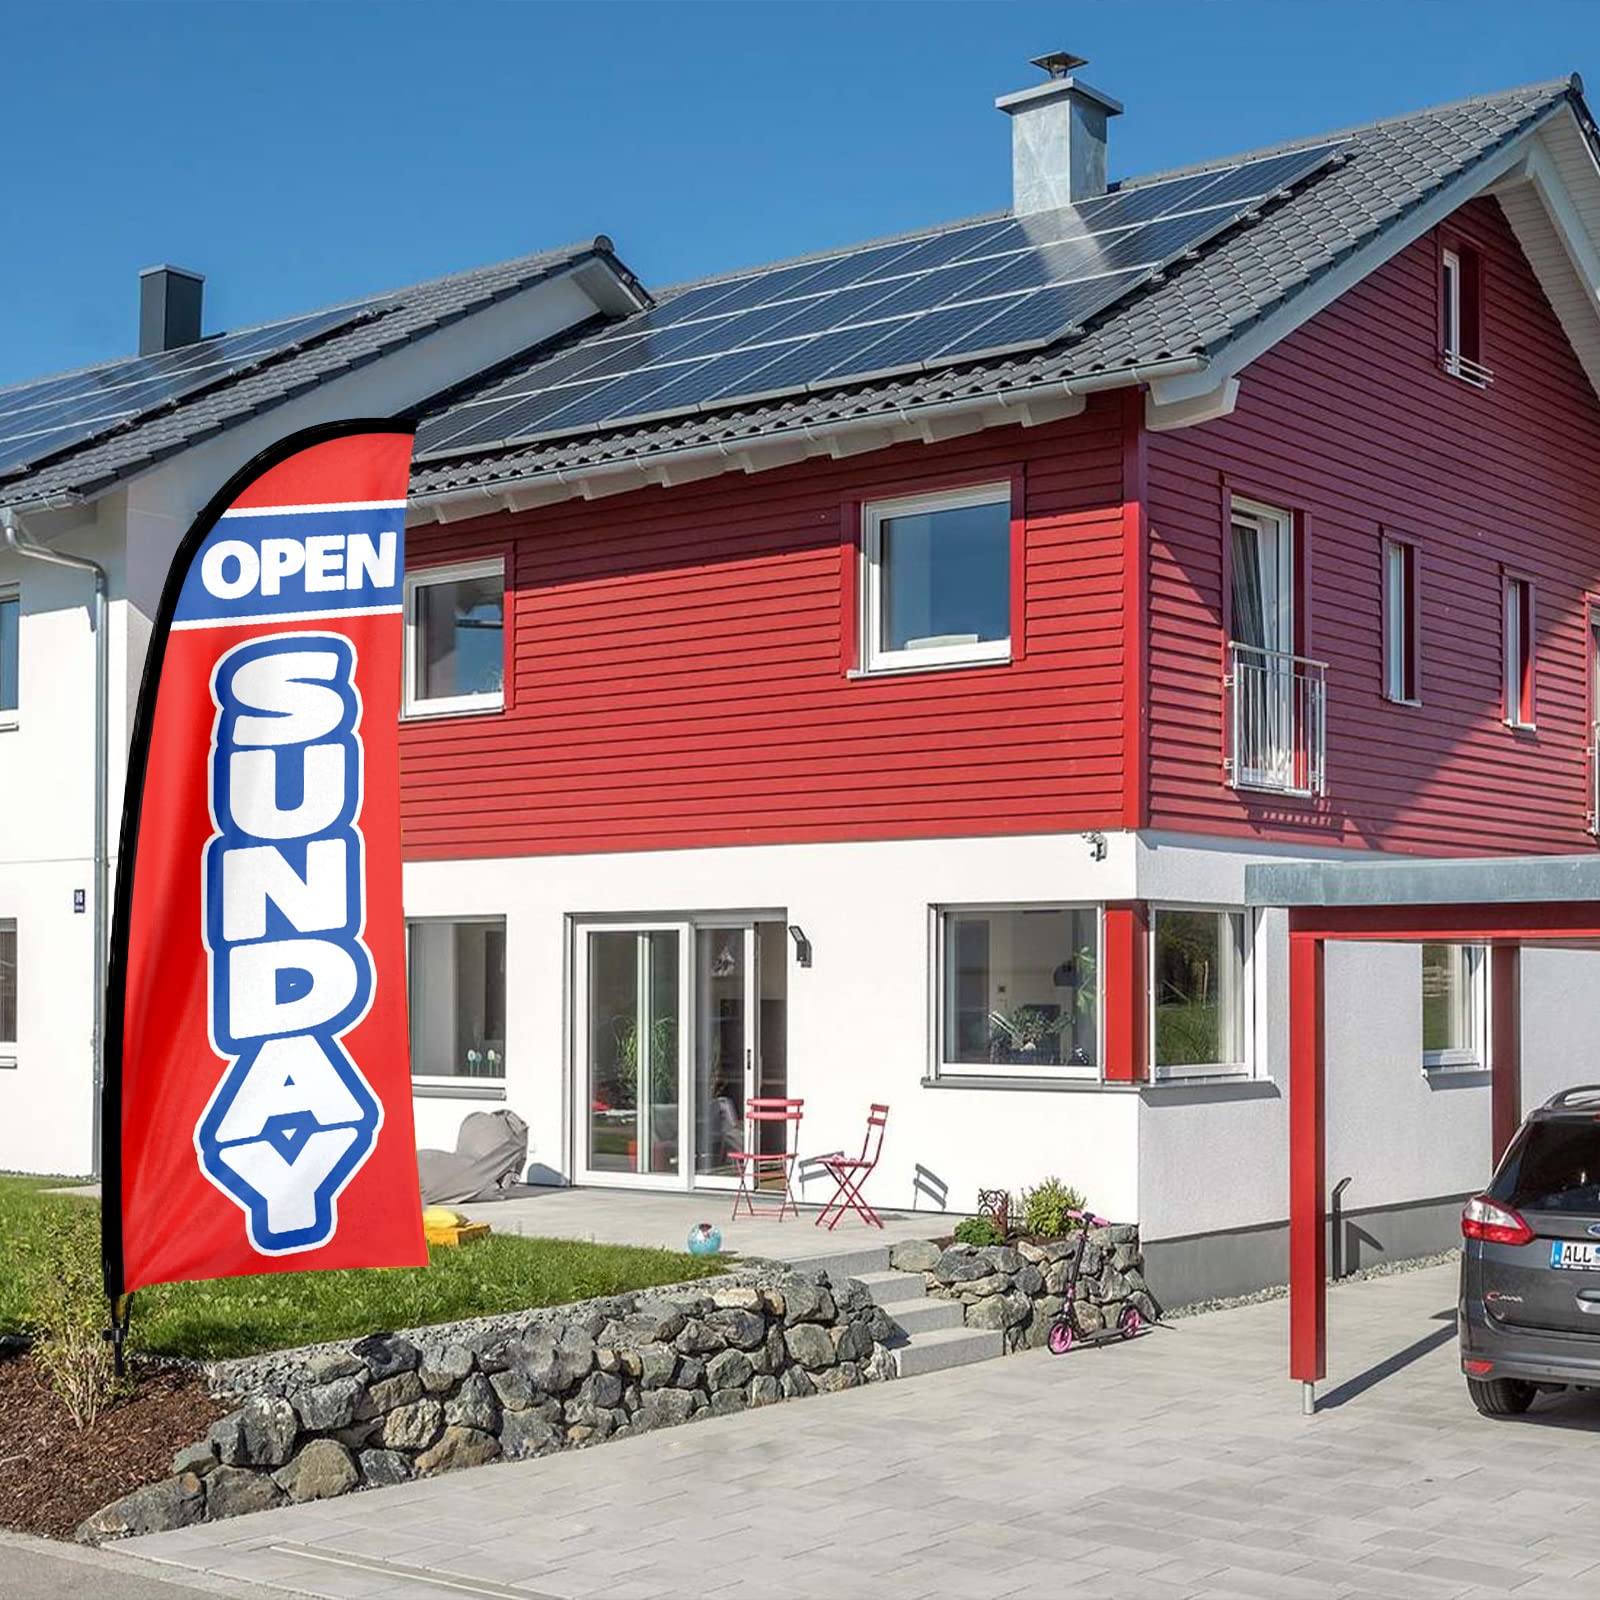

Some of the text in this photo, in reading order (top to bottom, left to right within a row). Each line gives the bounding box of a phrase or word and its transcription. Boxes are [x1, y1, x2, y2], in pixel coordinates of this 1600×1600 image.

[201, 531, 397, 600] OPEN
[209, 645, 370, 1241] SUNDAY
[1563, 1245, 1592, 1263] ALL
